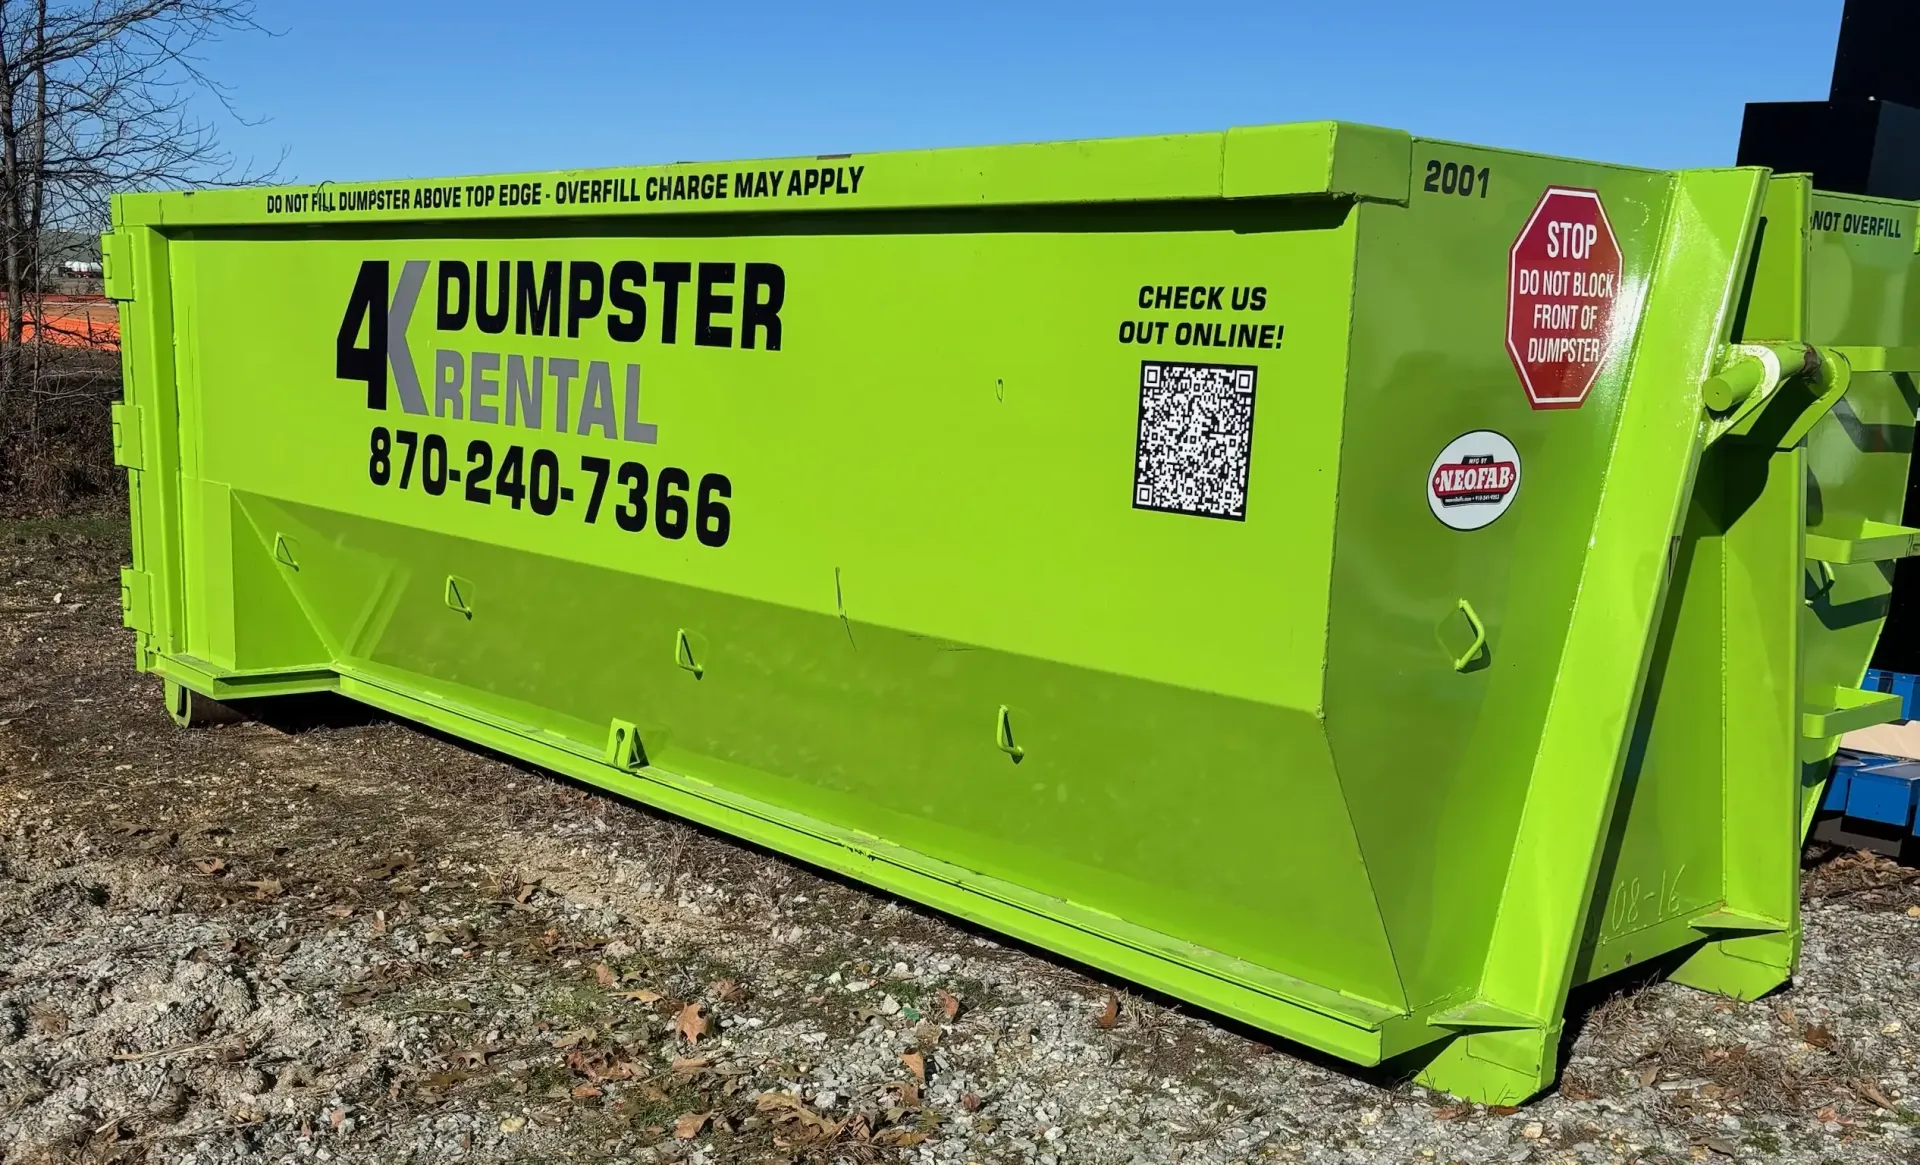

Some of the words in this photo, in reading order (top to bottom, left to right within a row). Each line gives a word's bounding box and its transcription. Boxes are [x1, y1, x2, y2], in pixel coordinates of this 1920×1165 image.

[267, 195, 283, 214] DO
[285, 193, 309, 213] NOT
[311, 190, 336, 213] FILL
[339, 189, 410, 211] DUMPSTER
[413, 186, 462, 209] ABOVE
[465, 185, 495, 207] TOP
[499, 183, 542, 207] EDGE
[555, 178, 641, 205] OVERFILL
[645, 173, 729, 202] CHARGE
[734, 170, 784, 198] MAY
[786, 165, 865, 197] APPLY
[1423, 159, 1490, 199] 2001
[1547, 220, 1598, 260] STOP
[1810, 210, 1842, 232] NOT
[1842, 213, 1901, 239] OVERFILL
[1138, 285, 1225, 311] CHECK
[1231, 286, 1267, 311] US
[1519, 268, 1540, 296] DO
[1542, 270, 1571, 297] NOT
[1572, 271, 1614, 299] BLOCK
[1118, 320, 1170, 345] OUT
[1174, 321, 1285, 349] ONLINE!
[1533, 303, 1579, 331] FRONT
[1580, 304, 1598, 331] OF
[336, 260, 430, 417] 4K
[436, 260, 786, 352] DUMPSTER
[1527, 337, 1600, 363] DUMPSTER
[434, 349, 659, 445] RENTAL
[369, 426, 732, 548] 870-240-7366
[1611, 863, 1686, 932] 08-16
